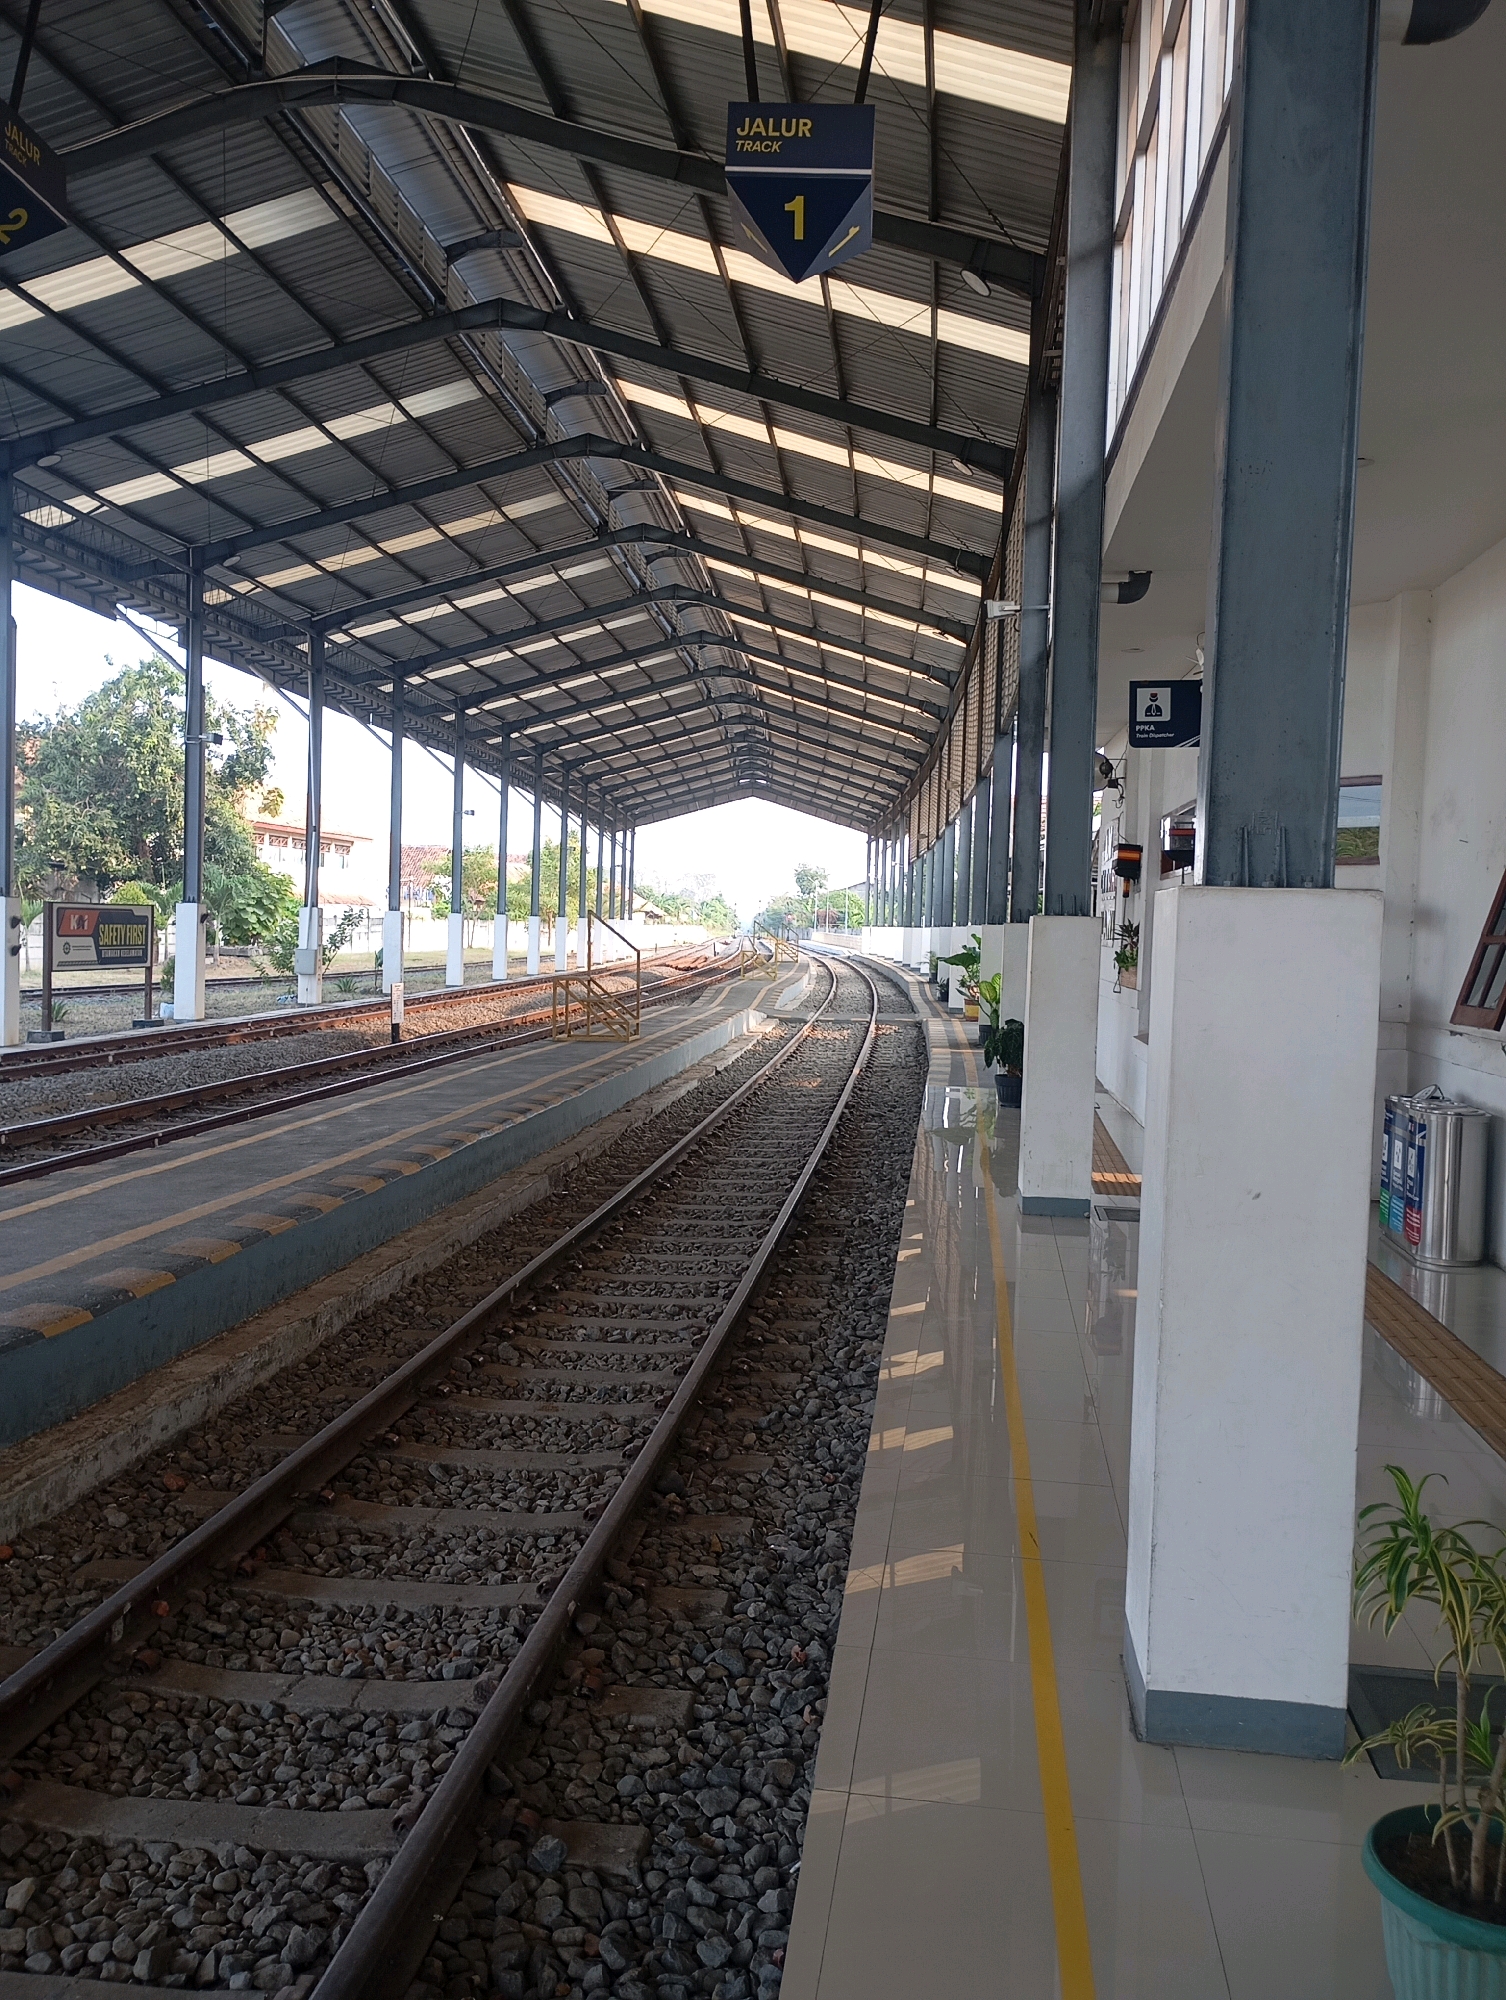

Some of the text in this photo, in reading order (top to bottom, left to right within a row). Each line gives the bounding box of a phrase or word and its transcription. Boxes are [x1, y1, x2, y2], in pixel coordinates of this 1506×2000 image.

[736, 117, 813, 138] JALUR
[4, 121, 42, 166] JALUR
[4, 138, 28, 168] TRACK
[735, 140, 783, 153] TRACK
[0, 207, 28, 246] 2
[784, 195, 805, 241] 1
[1135, 724, 1156, 732] PPKA
[98, 923, 147, 946] SAFETY FIRST
